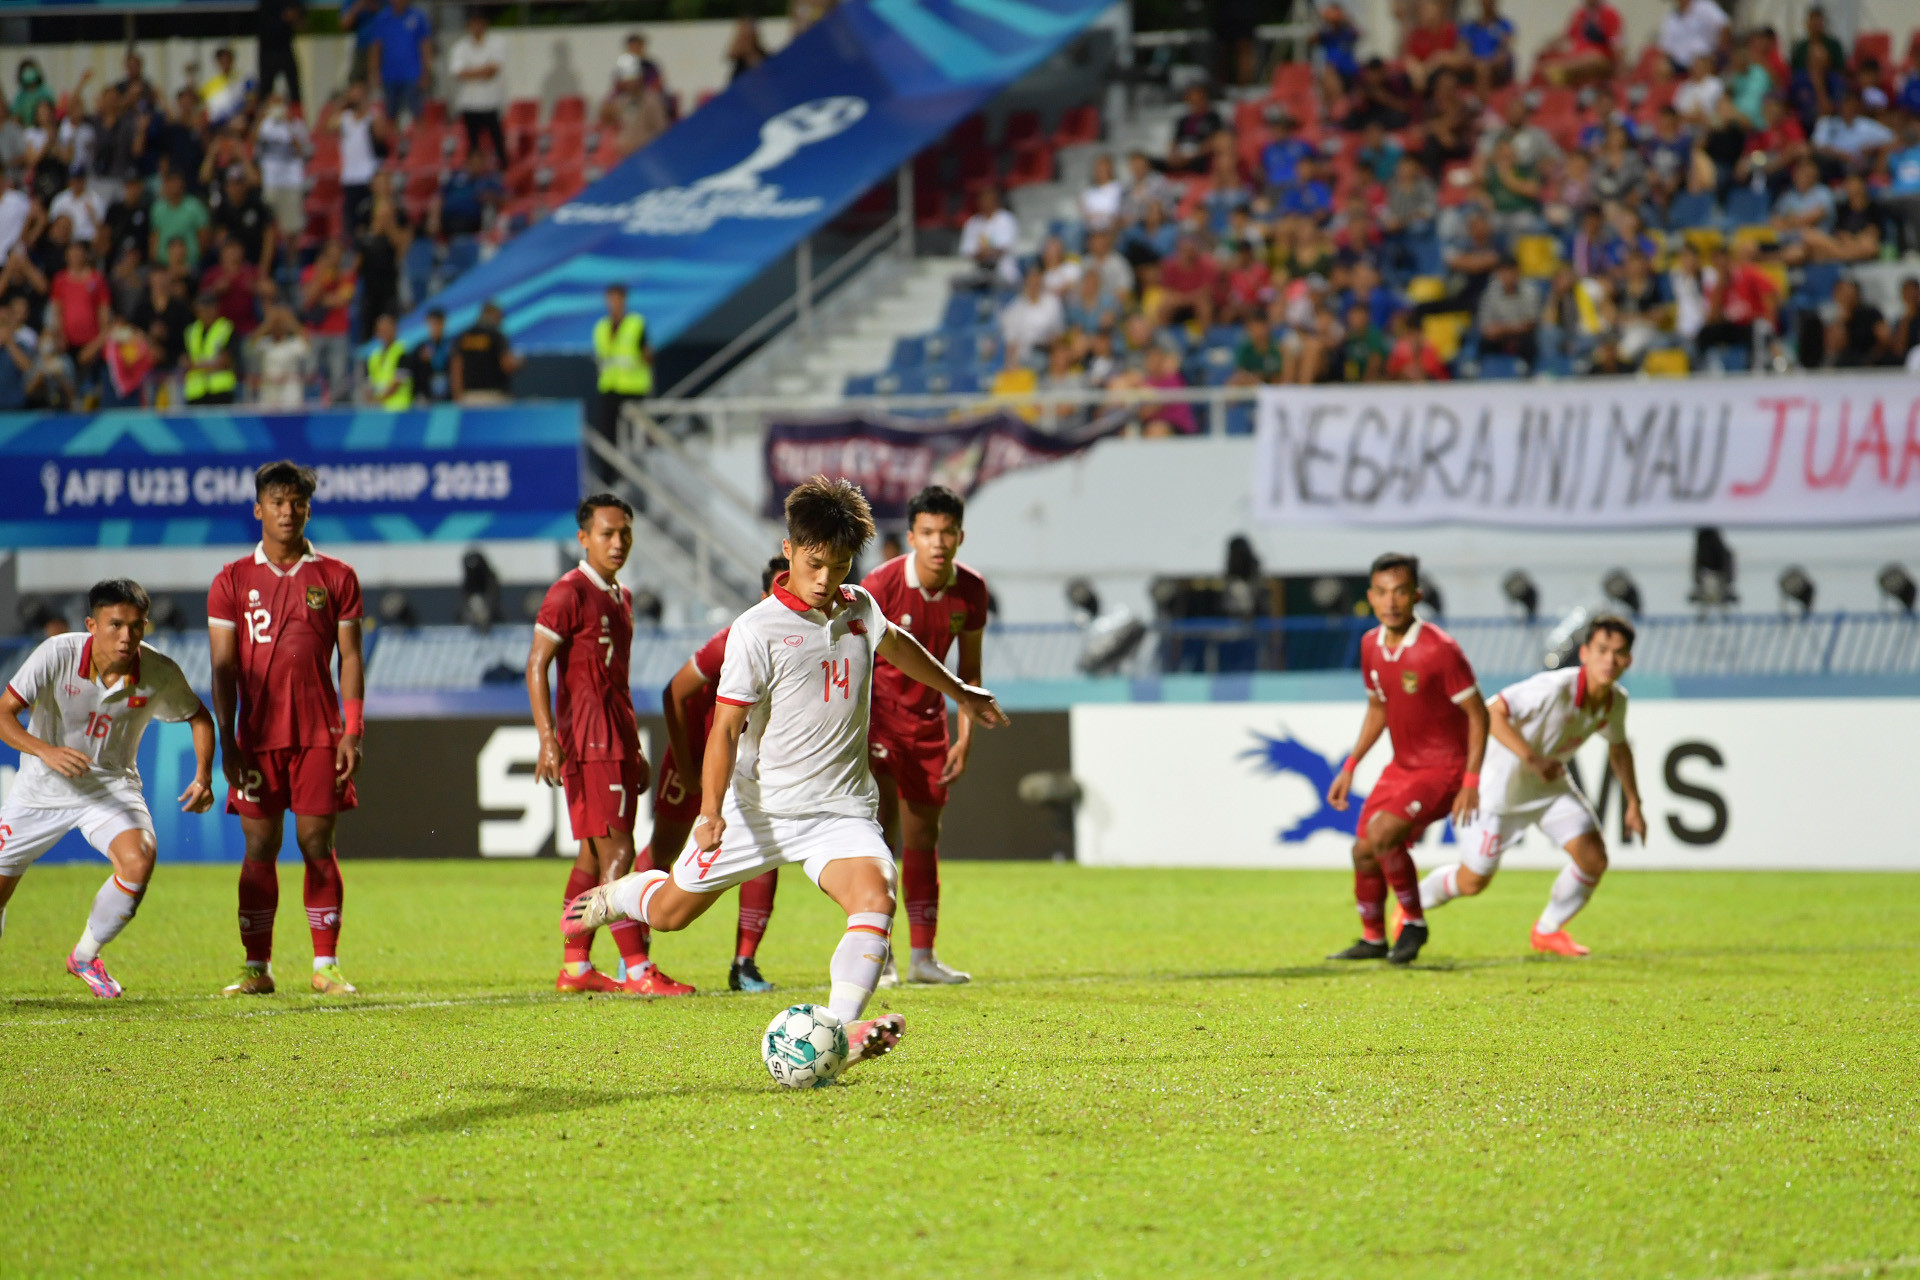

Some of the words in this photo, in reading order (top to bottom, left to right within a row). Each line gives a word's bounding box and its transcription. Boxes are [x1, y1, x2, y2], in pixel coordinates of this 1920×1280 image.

[1270, 402, 1494, 507] NEGARA
[1506, 402, 1592, 508] INI
[1592, 402, 1731, 507] MAU
[62, 468, 125, 506] AFF
[129, 466, 189, 505] U23
[432, 460, 511, 500] 2023
[244, 608, 272, 645] 12
[598, 636, 614, 668] 7
[822, 658, 849, 702] 14
[86, 711, 113, 738] 16
[609, 784, 627, 818] 7
[660, 769, 686, 806] 15
[1479, 829, 1502, 858] 10
